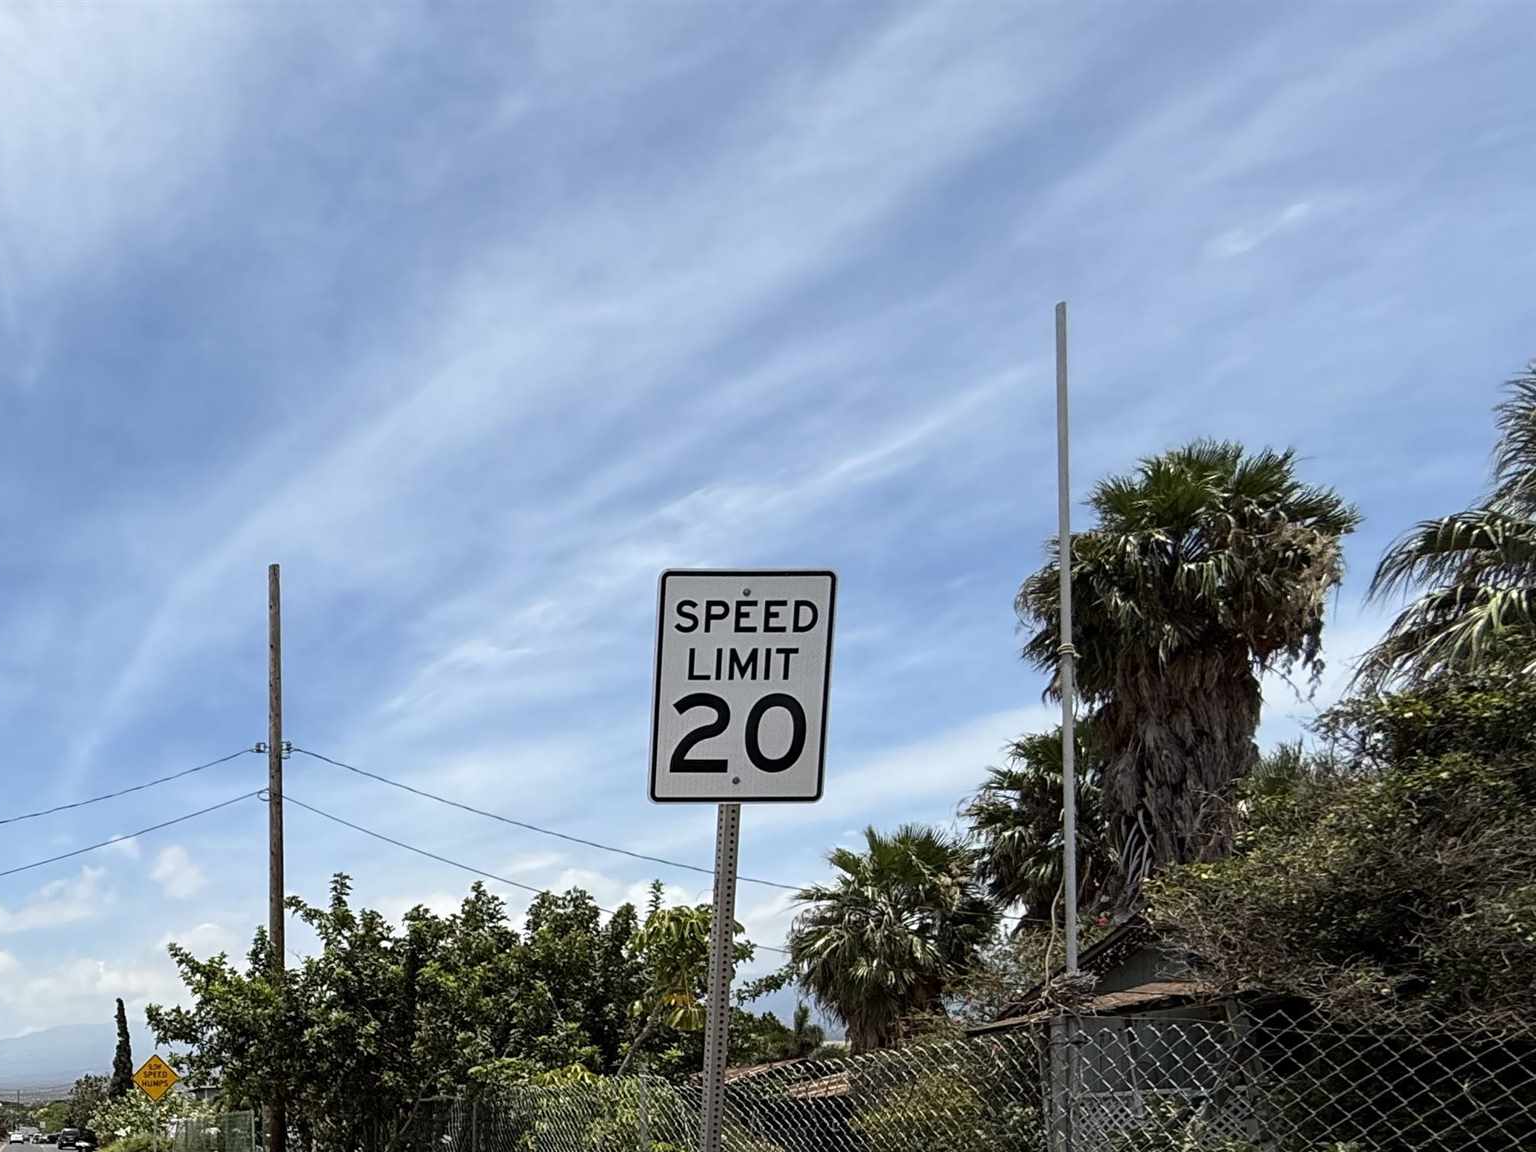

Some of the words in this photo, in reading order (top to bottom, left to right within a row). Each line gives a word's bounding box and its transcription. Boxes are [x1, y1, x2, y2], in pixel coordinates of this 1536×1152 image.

[674, 600, 819, 633] SPEED
[687, 648, 799, 681] LIMIT
[669, 692, 807, 773] 20
[141, 1079, 169, 1087] HUMPS
